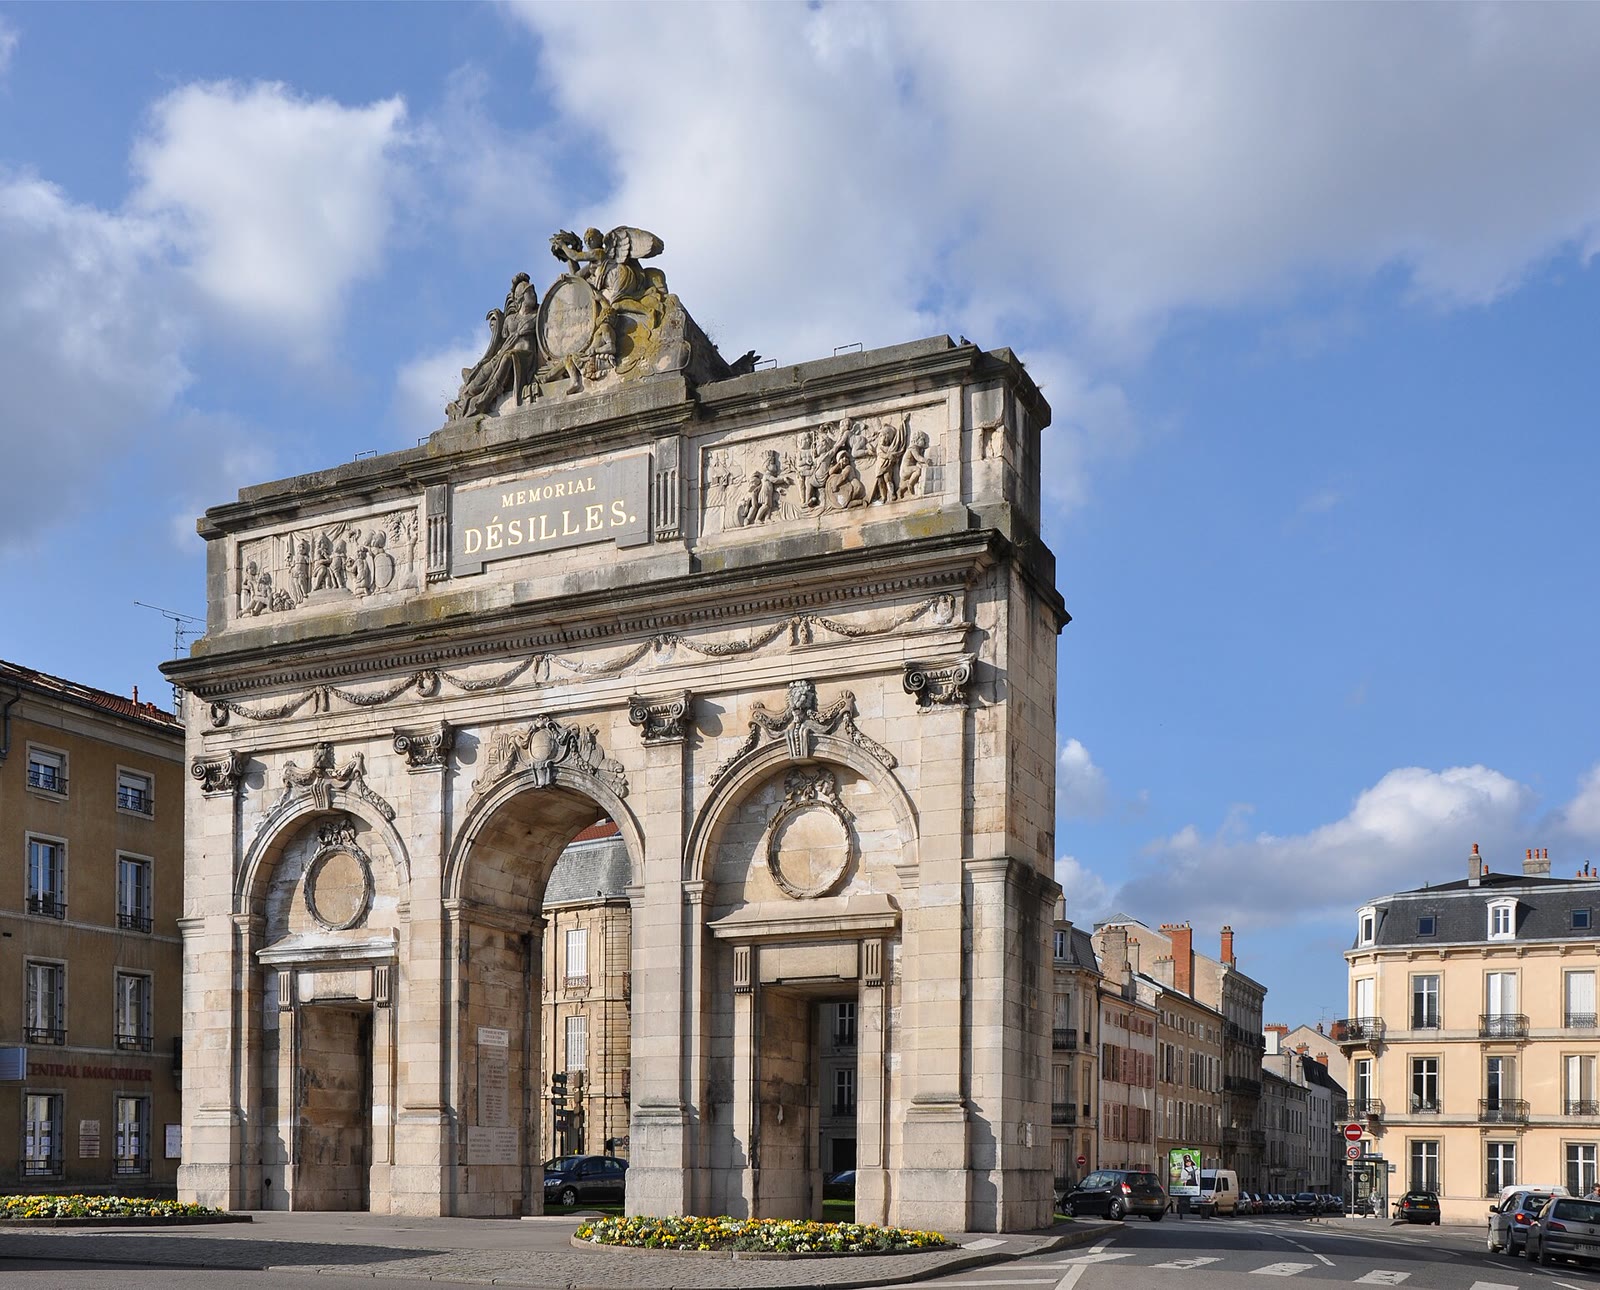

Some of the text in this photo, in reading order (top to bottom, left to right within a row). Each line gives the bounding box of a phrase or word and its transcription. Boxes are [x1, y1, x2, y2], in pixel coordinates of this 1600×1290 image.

[502, 477, 596, 508] MEMORIAL
[464, 500, 636, 554] DÉSILLES.
[82, 1065, 153, 1081] IMMOBILIER
